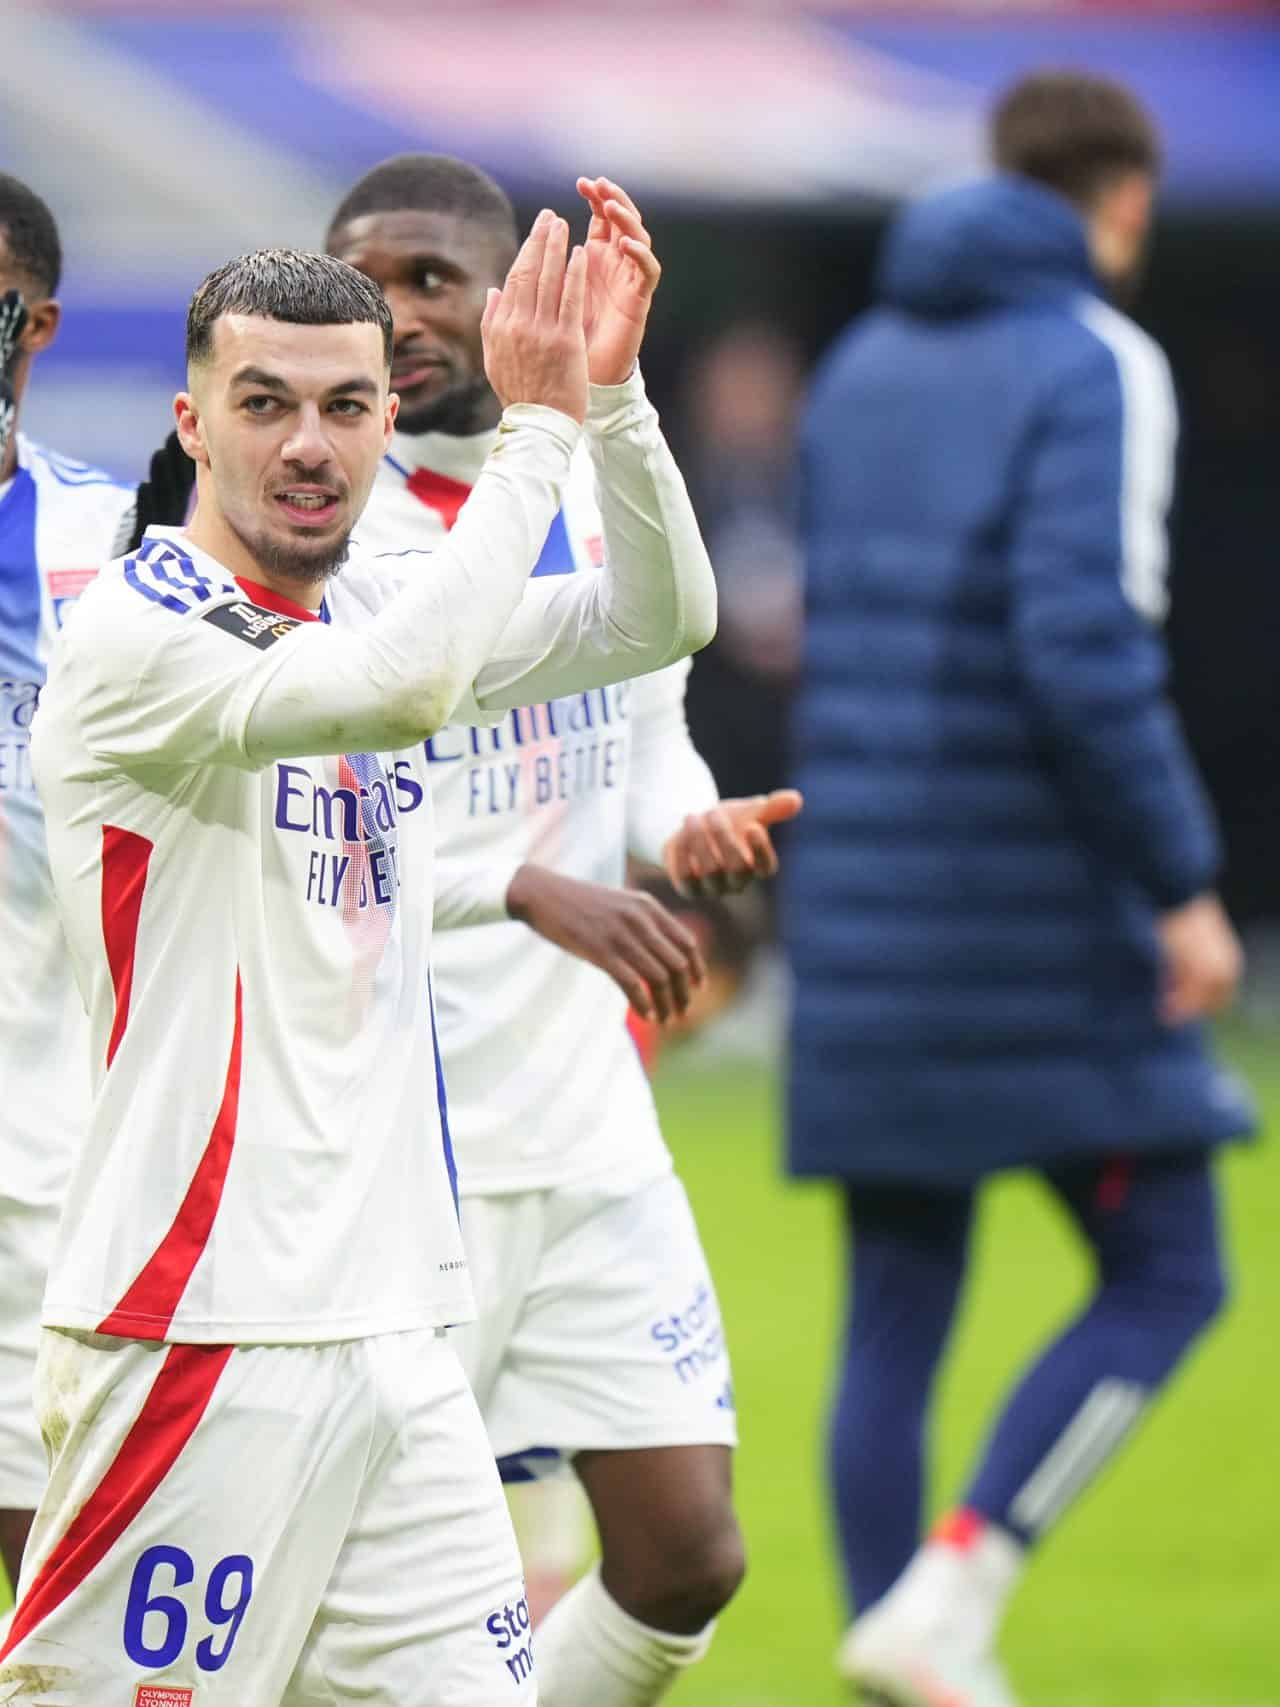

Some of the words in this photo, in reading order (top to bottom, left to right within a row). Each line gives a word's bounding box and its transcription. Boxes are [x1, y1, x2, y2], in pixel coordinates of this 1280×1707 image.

[469, 763, 521, 816] FLY
[307, 850, 350, 907] FLY
[123, 1544, 254, 1673] 69
[140, 1690, 190, 1701] OLYMPIQUE
